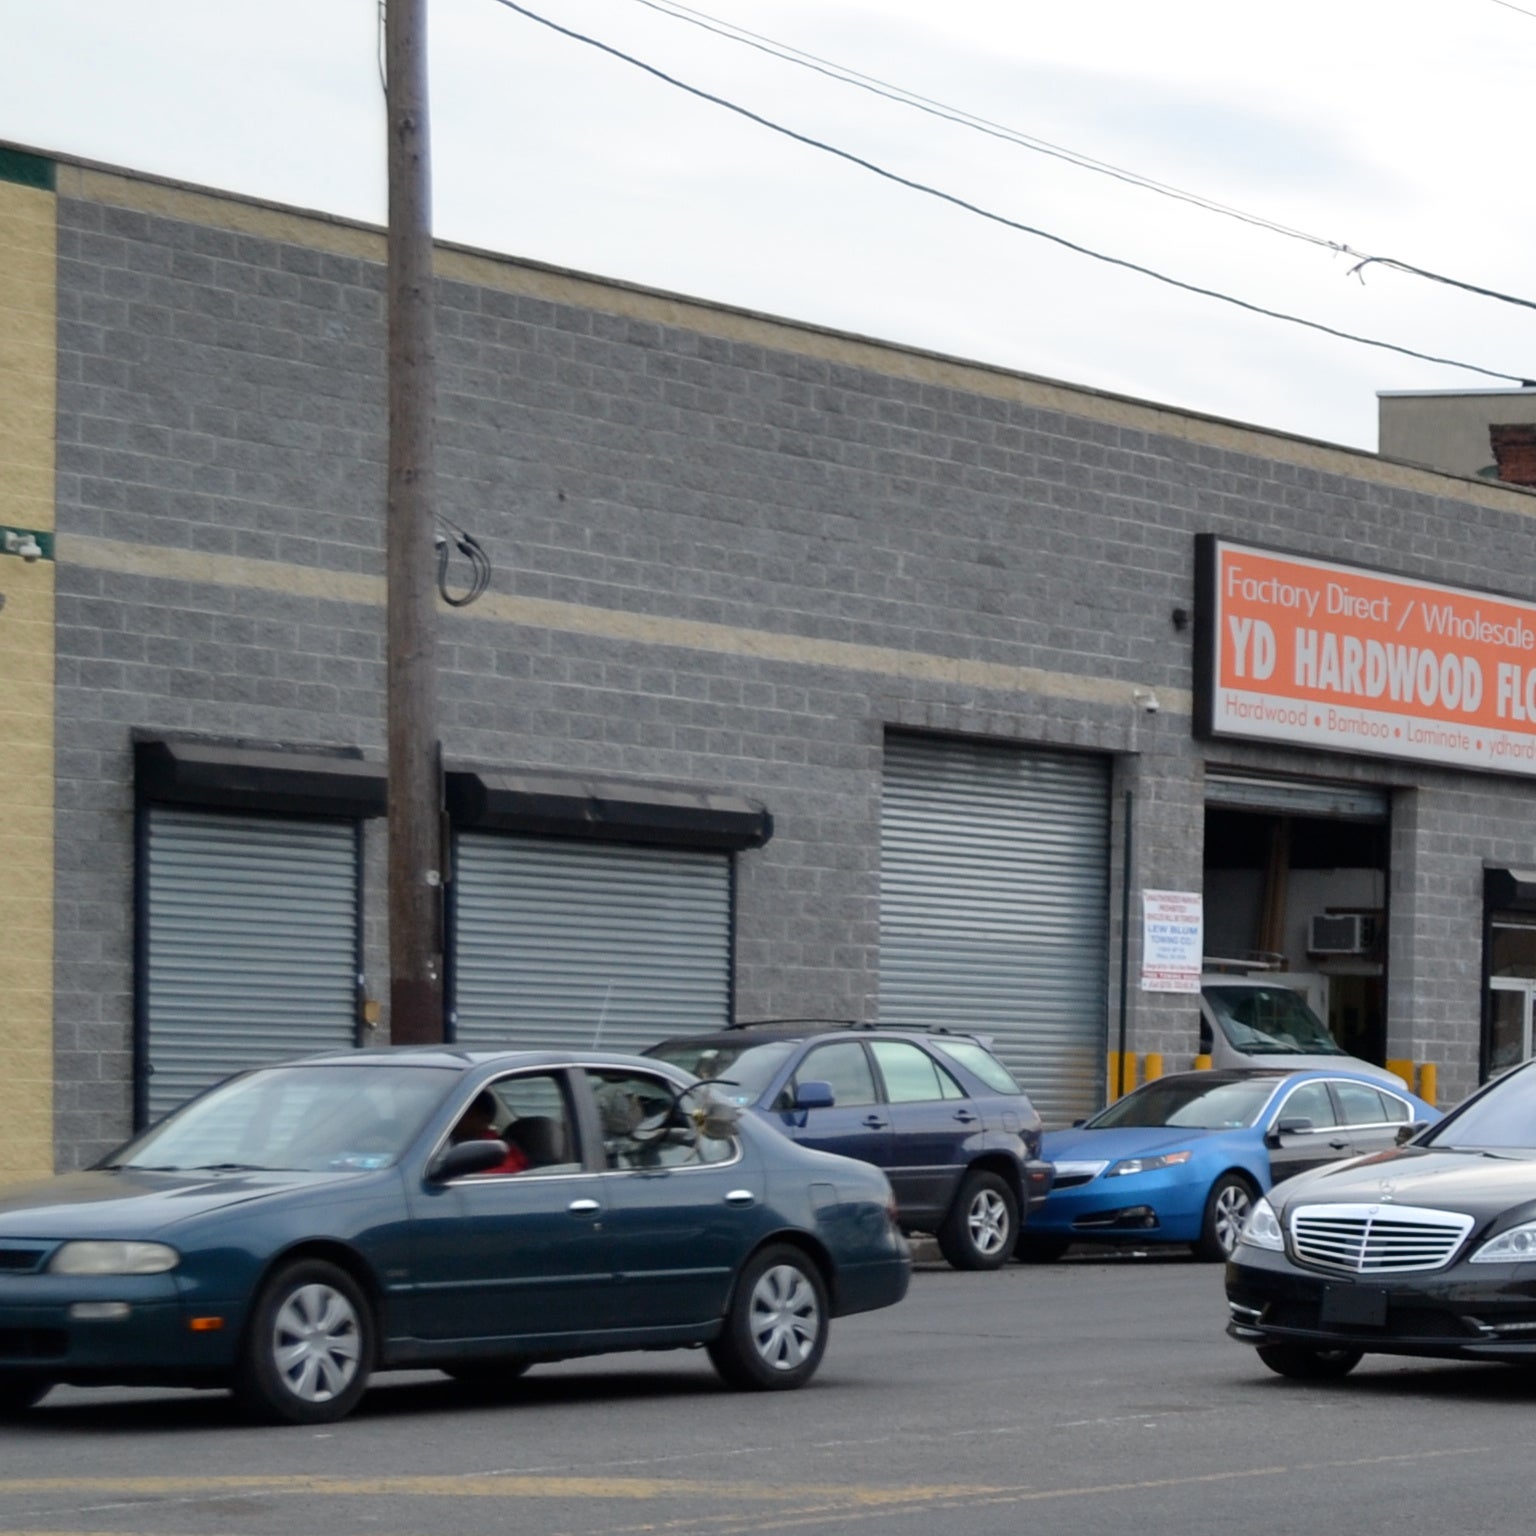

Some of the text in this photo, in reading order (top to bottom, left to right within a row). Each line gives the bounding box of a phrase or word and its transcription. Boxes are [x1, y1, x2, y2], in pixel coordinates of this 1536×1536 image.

[1227, 565, 1320, 618] Factory
[1326, 582, 1392, 623] Direct
[1421, 601, 1535, 650] Wholesale
[1228, 615, 1277, 681] YD
[1294, 626, 1484, 713] HARDWOOD
[1225, 692, 1309, 728] Hardwood
[1327, 707, 1390, 739] Bamboo
[1406, 720, 1470, 751] Laminate
[1170, 925, 1198, 935] BLUM
